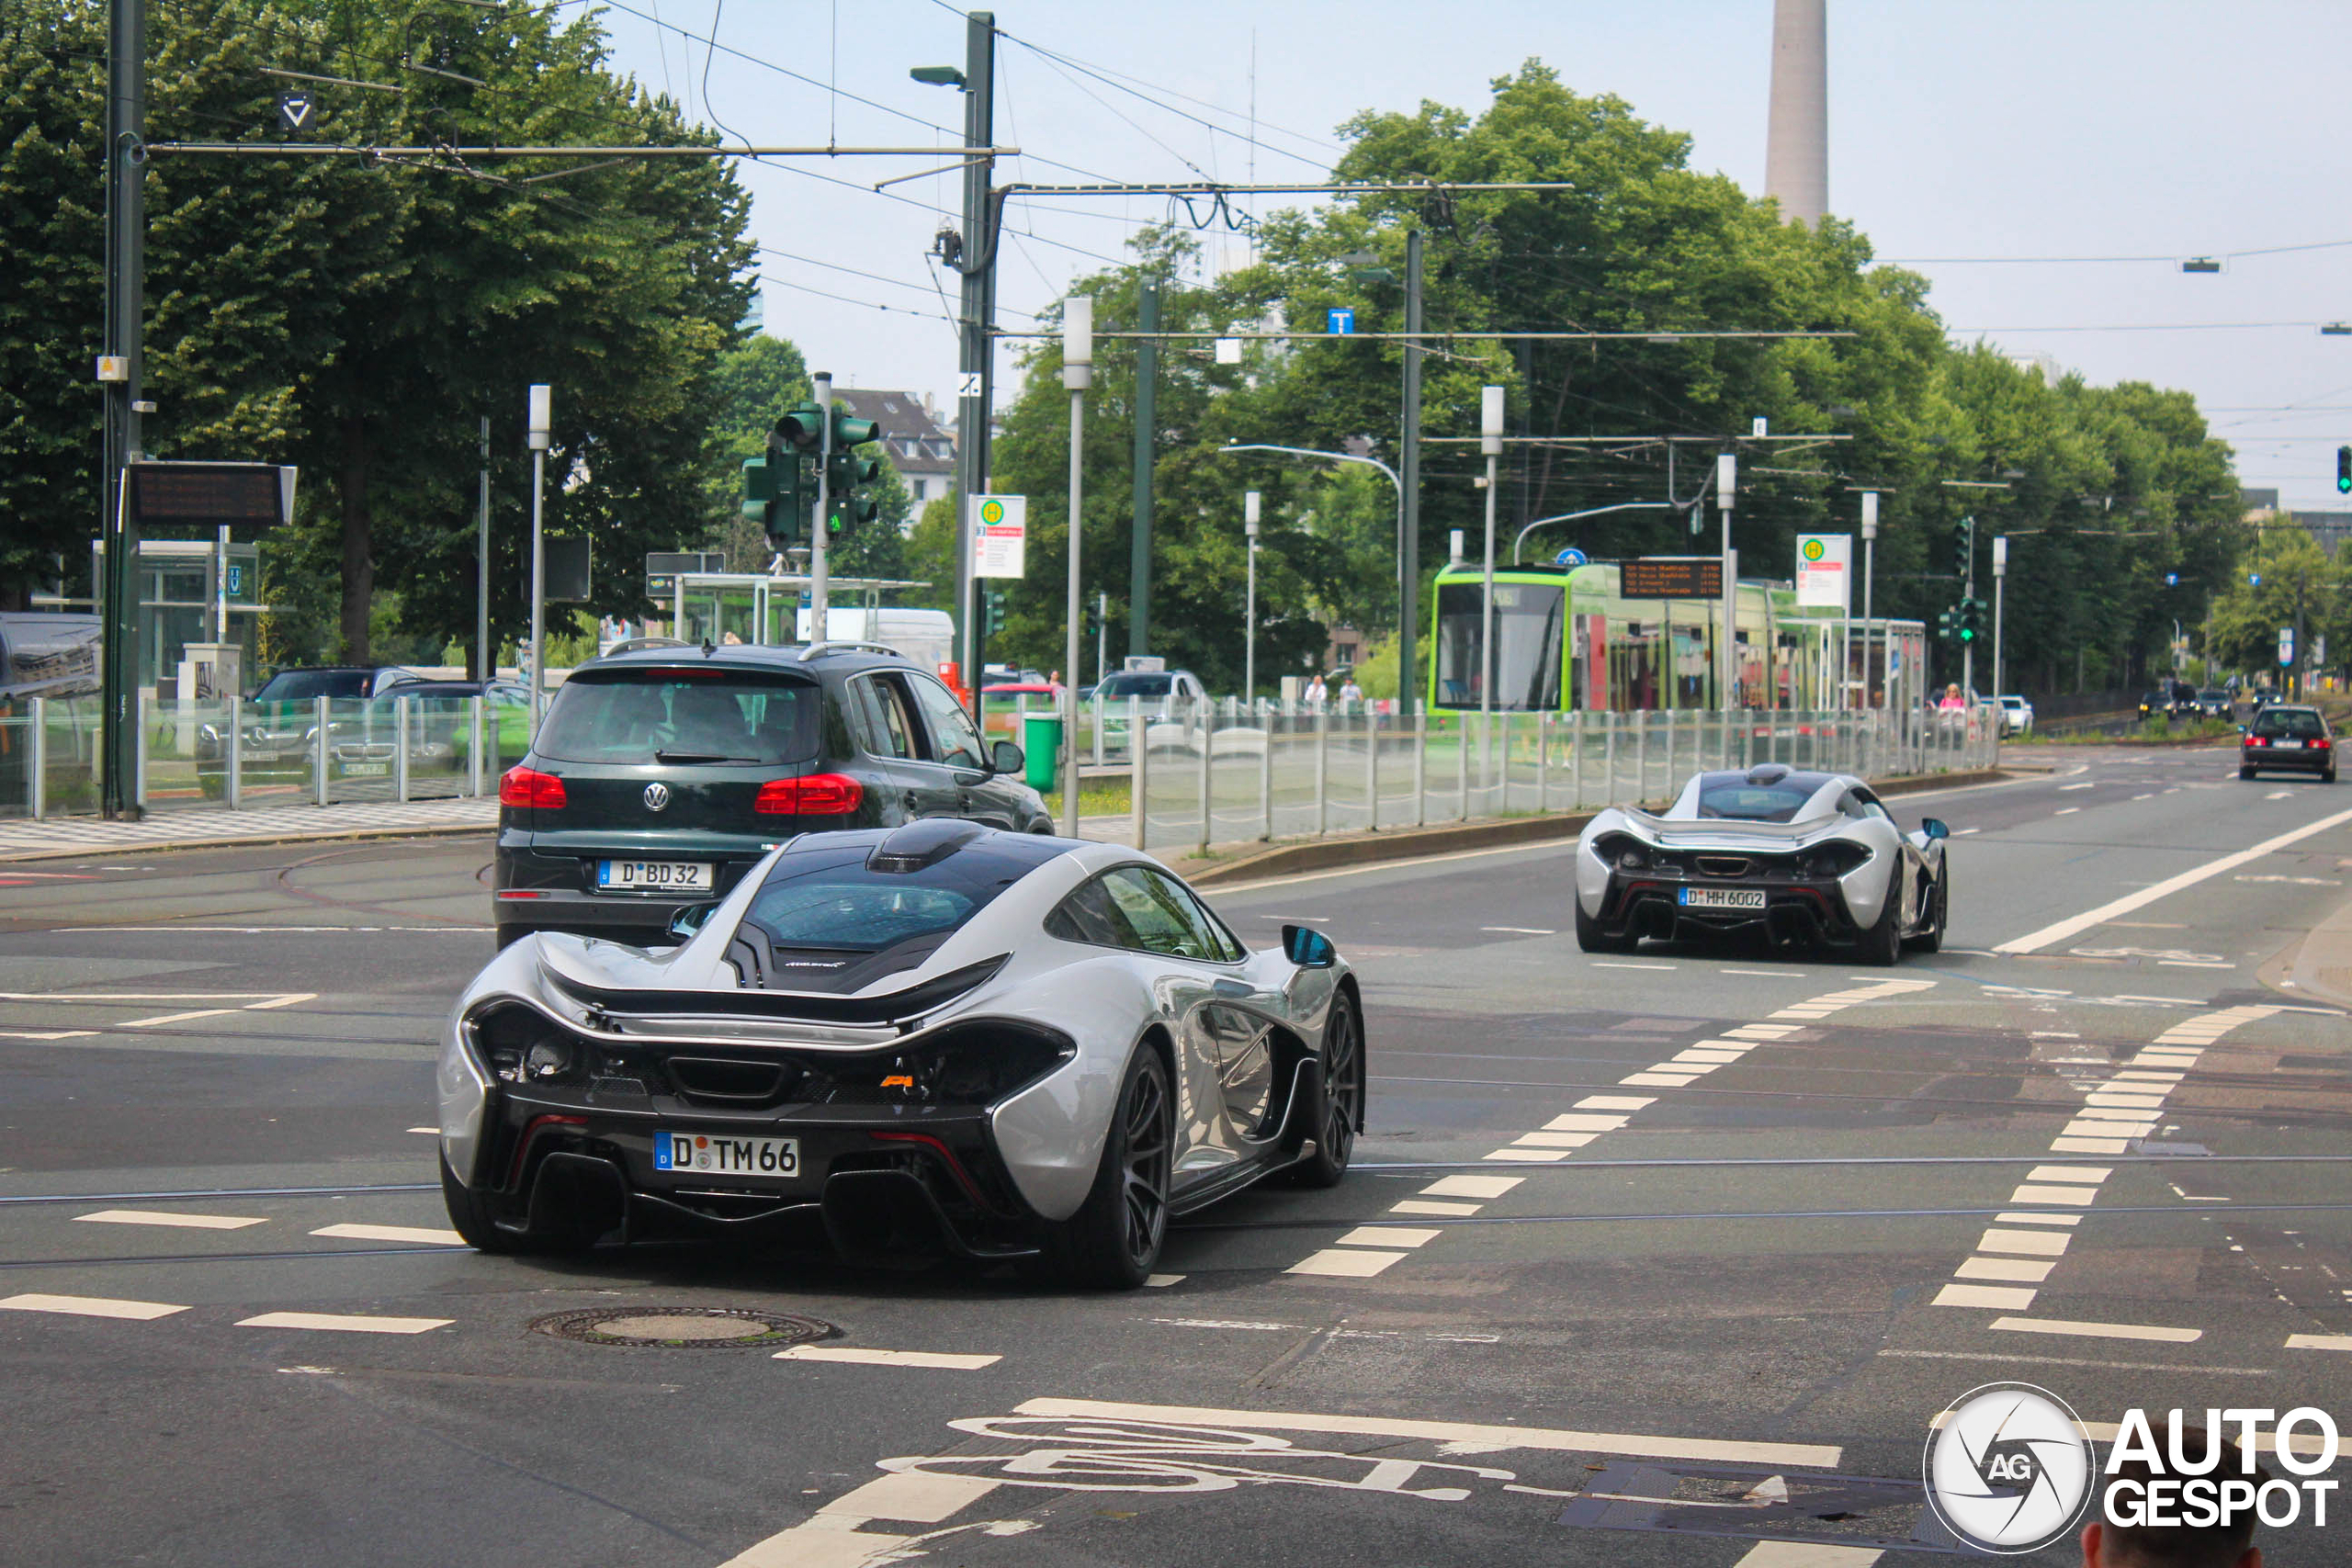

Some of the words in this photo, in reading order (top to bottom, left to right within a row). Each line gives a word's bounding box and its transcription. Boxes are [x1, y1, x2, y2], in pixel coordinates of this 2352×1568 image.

[987, 505, 998, 520] H
[1809, 544, 1818, 556] H
[622, 863, 634, 882] D
[646, 864, 671, 884] BD
[674, 865, 698, 885] 32
[1689, 890, 1697, 904] D
[1706, 891, 1724, 905] HH
[1728, 892, 1762, 907] 6002
[660, 1155, 668, 1164] D
[673, 1137, 692, 1167] D
[713, 1139, 753, 1170] TM
[759, 1142, 797, 1172] 66
